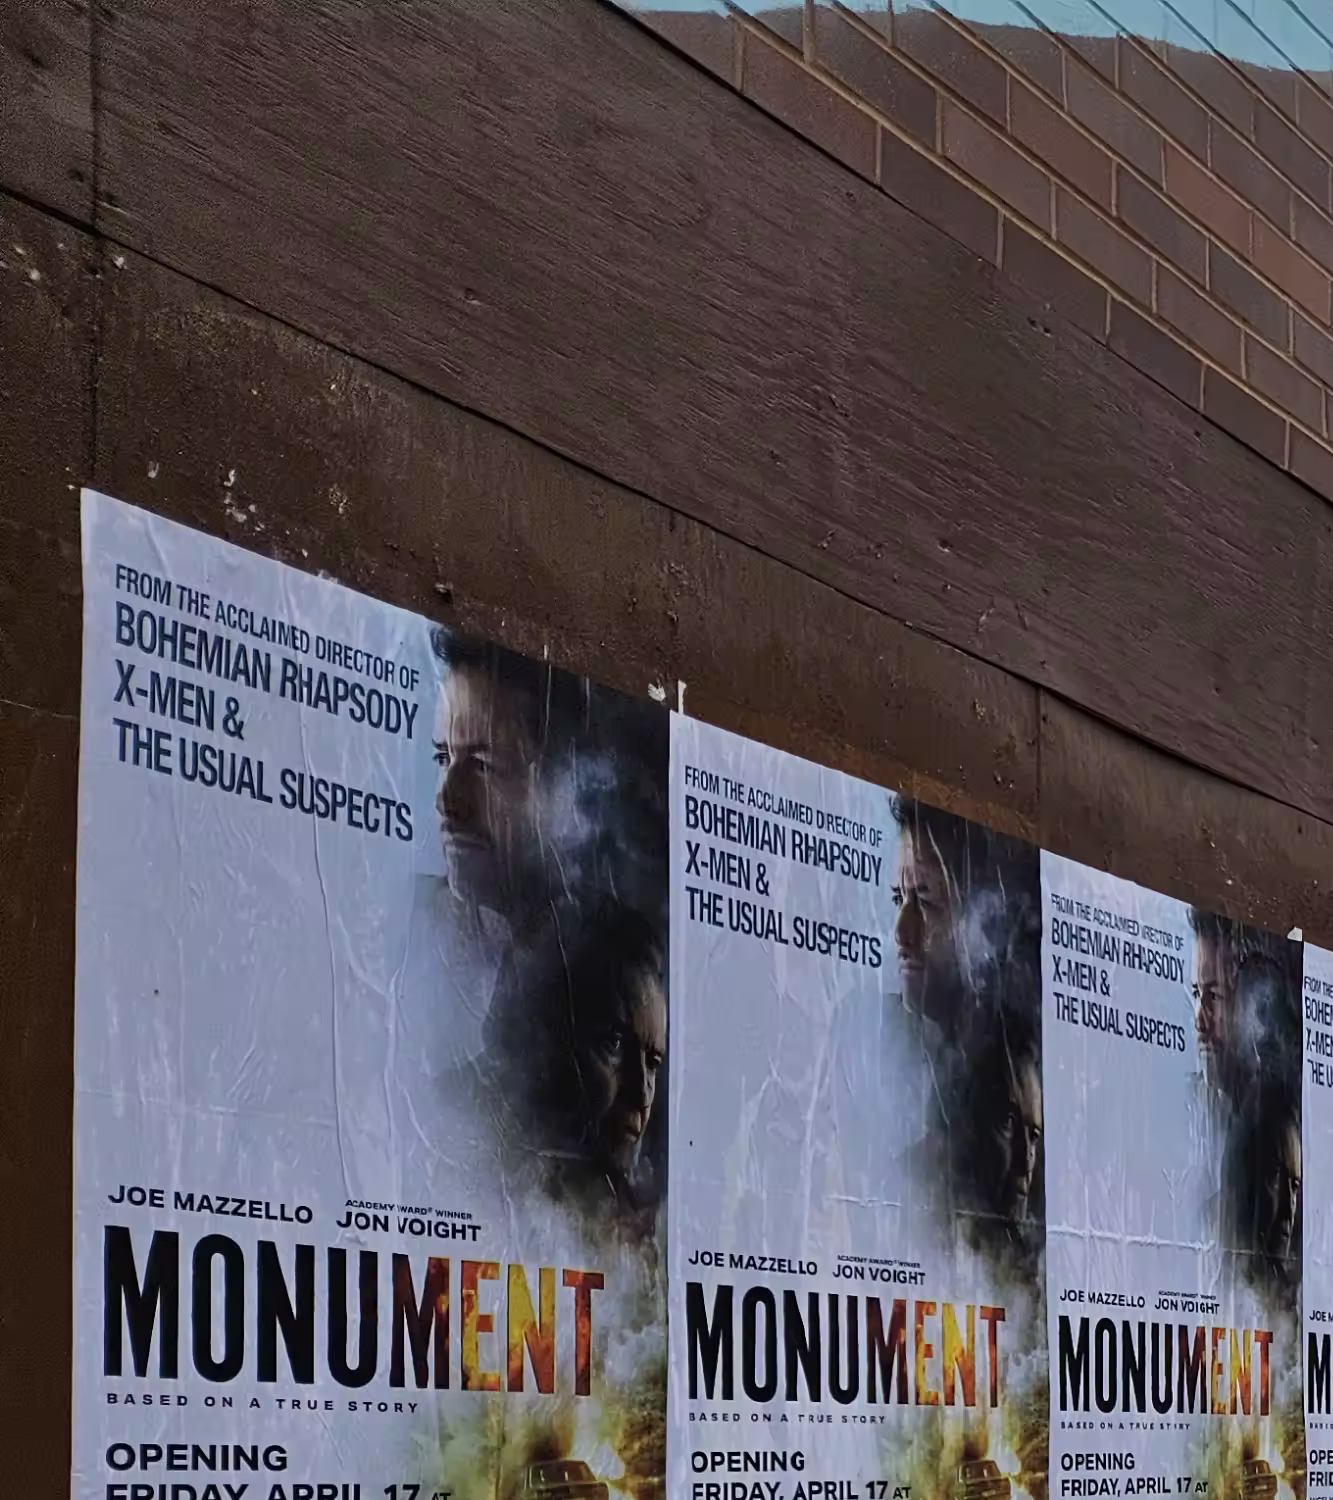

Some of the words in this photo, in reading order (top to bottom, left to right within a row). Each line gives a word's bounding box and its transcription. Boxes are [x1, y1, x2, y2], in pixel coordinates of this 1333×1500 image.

[116, 564, 171, 606] FROM
[177, 585, 210, 620] THE
[215, 601, 310, 654] ACCLAIMED
[316, 636, 395, 684] DIRECTOR
[400, 666, 419, 691] OF
[114, 659, 214, 731] X-MEN
[223, 697, 244, 740] &
[116, 601, 271, 692] BOHEMIAN
[280, 658, 418, 739] RHAPSODY
[113, 718, 172, 775] THE
[180, 738, 272, 803] USUAL
[280, 769, 413, 841] SUSPECTS
[685, 840, 750, 891] X-MEN
[756, 863, 769, 896] &
[686, 795, 785, 857] BOHEMIAN
[792, 829, 881, 886] RHAPSODY
[686, 886, 724, 927] THE
[729, 898, 788, 945] USUAL
[793, 916, 881, 968] SUSPECTS
[1052, 918, 1120, 964] BOHEMIAN
[1123, 941, 1184, 984] RHAPSODY
[1053, 955, 1097, 993] X-MEN
[1100, 970, 1110, 996] &
[1053, 992, 1078, 1024] THE
[1082, 1000, 1123, 1036] USUAL
[1126, 1012, 1185, 1052] SUSPECTS
[108, 1185, 164, 1208] JOE
[175, 1192, 312, 1223] MAZZELLO
[336, 1212, 388, 1232] JON
[398, 1216, 481, 1241] VOIGHT
[104, 1226, 604, 1396] MONUMENT
[687, 1283, 1005, 1406] MONUMENT
[1060, 1316, 1274, 1415] MONUMENT
[107, 1393, 187, 1406] BASED
[204, 1396, 232, 1407] ON
[250, 1398, 260, 1408] A
[276, 1399, 333, 1410] TRUE
[348, 1401, 417, 1413] STORY
[106, 1443, 287, 1471] OPENING
[692, 1451, 804, 1473] OPENING
[1061, 1453, 1134, 1471] OPENING
[793, 1481, 858, 1500] APRIL
[866, 1481, 888, 1499] 17
[893, 1486, 910, 1499] AT
